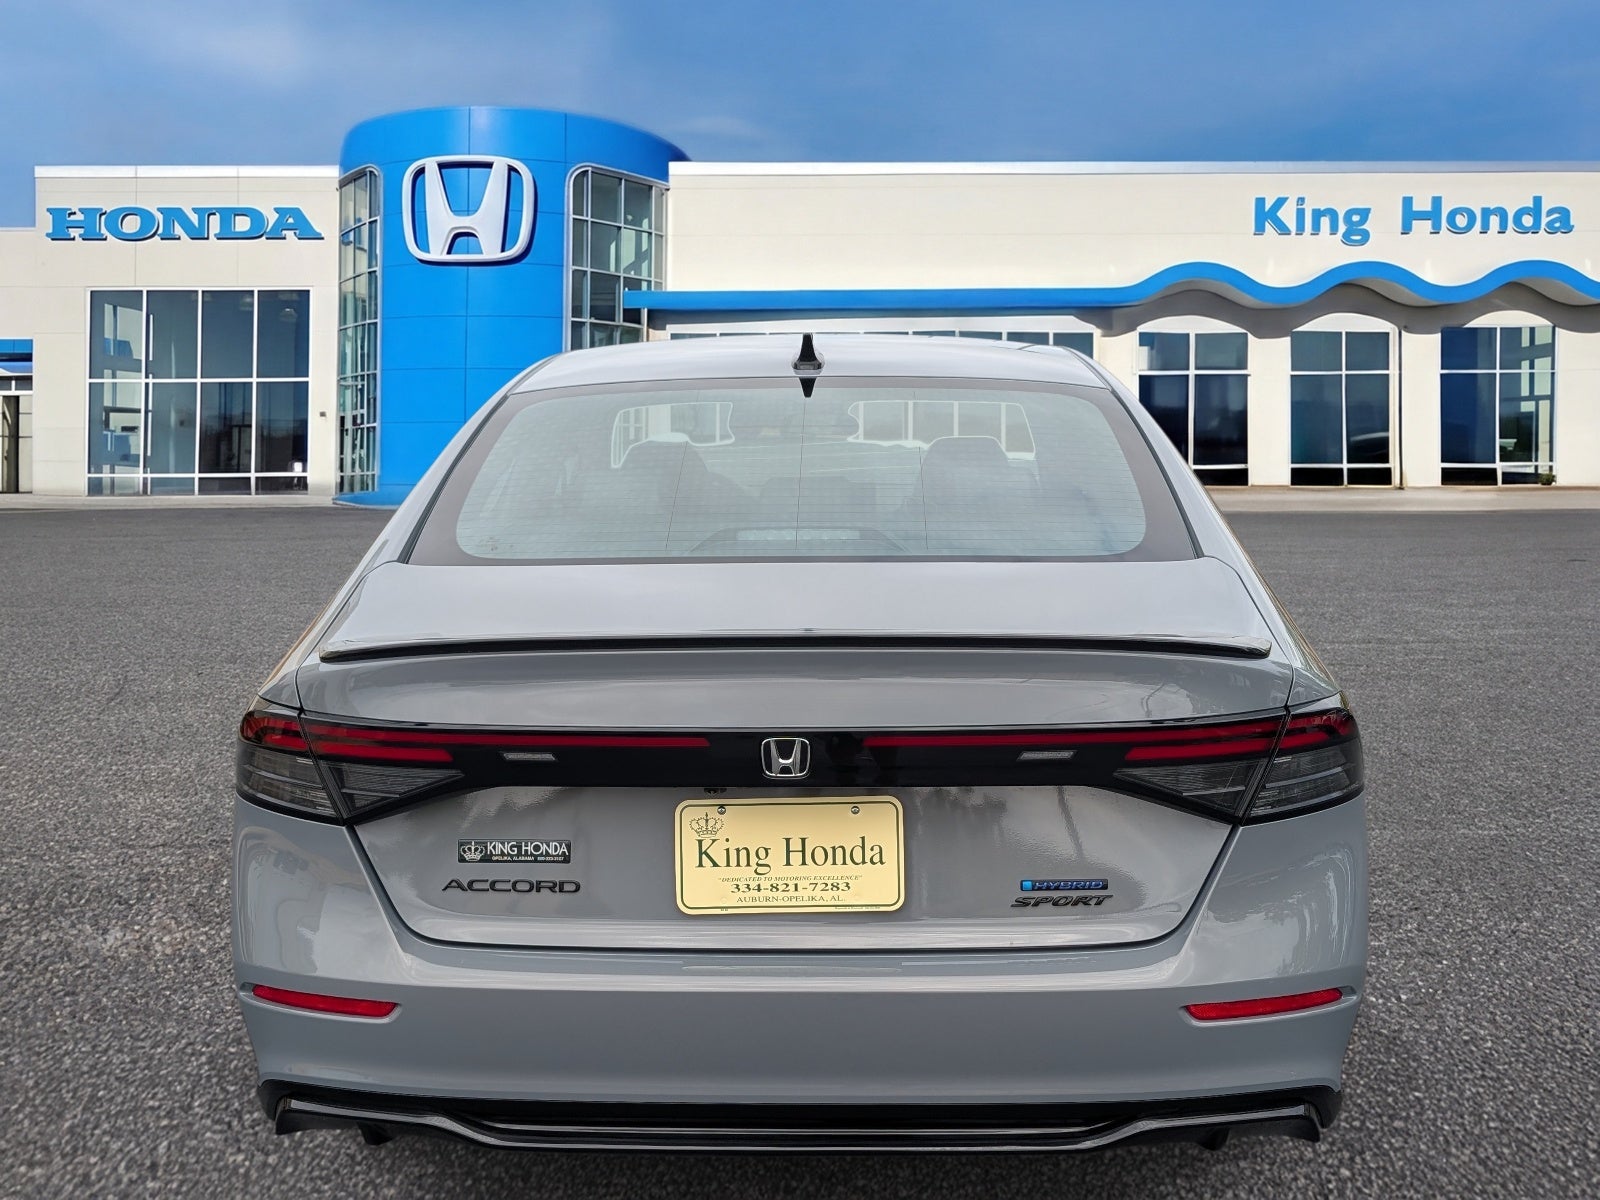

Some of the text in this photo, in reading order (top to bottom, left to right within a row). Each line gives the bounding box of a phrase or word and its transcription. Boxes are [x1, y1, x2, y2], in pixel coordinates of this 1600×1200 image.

[46, 206, 324, 241] HONDA
[1253, 195, 1575, 246] King Honda
[487, 841, 569, 855] KING HONDA
[695, 836, 886, 875] King Honda
[441, 878, 581, 893] ACCORD
[730, 882, 851, 893] 334-821-7283
[1033, 880, 1103, 889] HYBRID
[1010, 895, 1114, 907] SPORT
